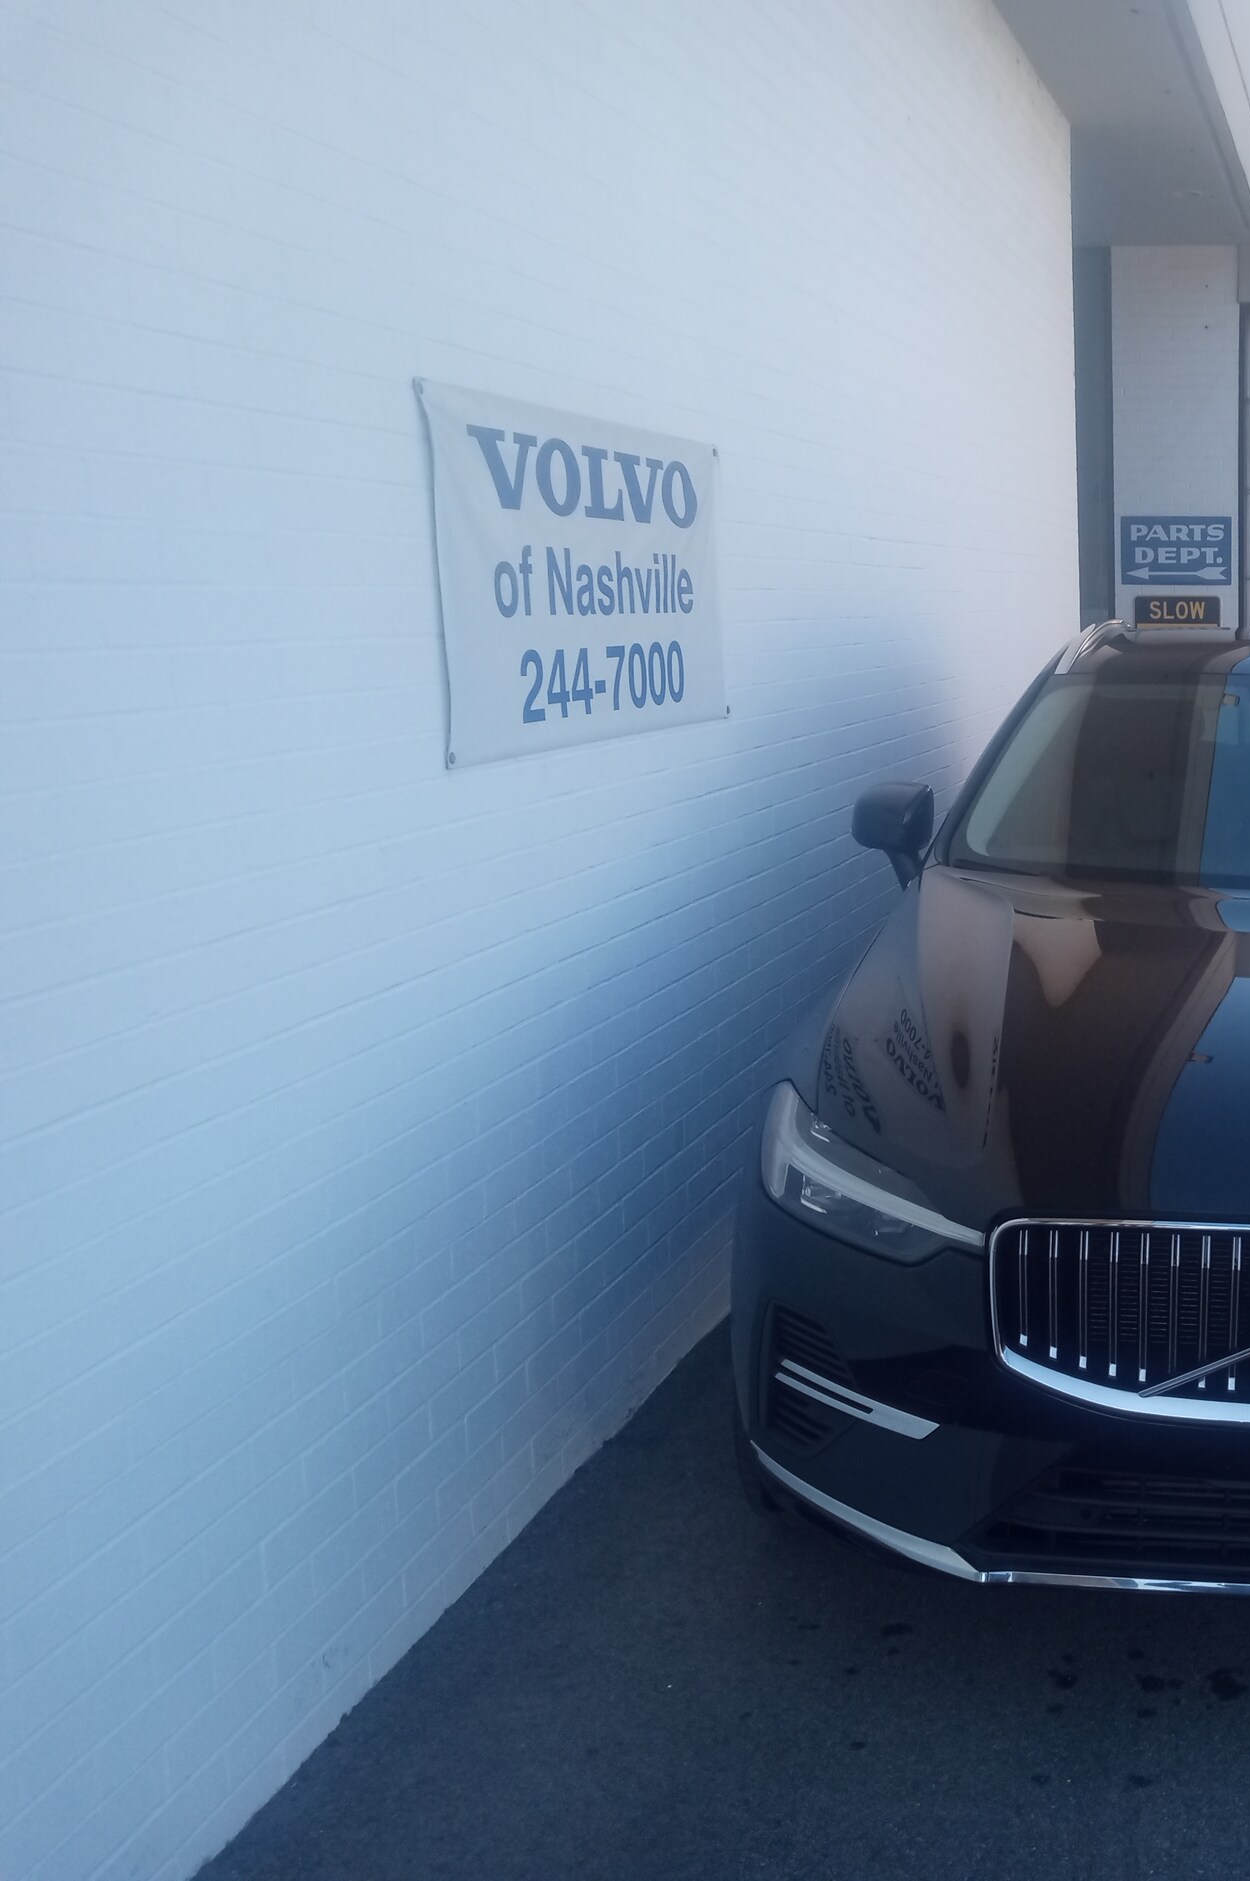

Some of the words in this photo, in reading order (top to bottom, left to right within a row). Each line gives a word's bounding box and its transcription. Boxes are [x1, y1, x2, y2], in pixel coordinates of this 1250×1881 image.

[465, 423, 698, 529] VOLVO
[1130, 523, 1225, 542] PARTS
[1134, 546, 1223, 564] DEPT.
[494, 545, 533, 618] of
[545, 546, 694, 617] Nashville
[1149, 600, 1206, 620] SLOW
[519, 639, 685, 724] 244-7000
